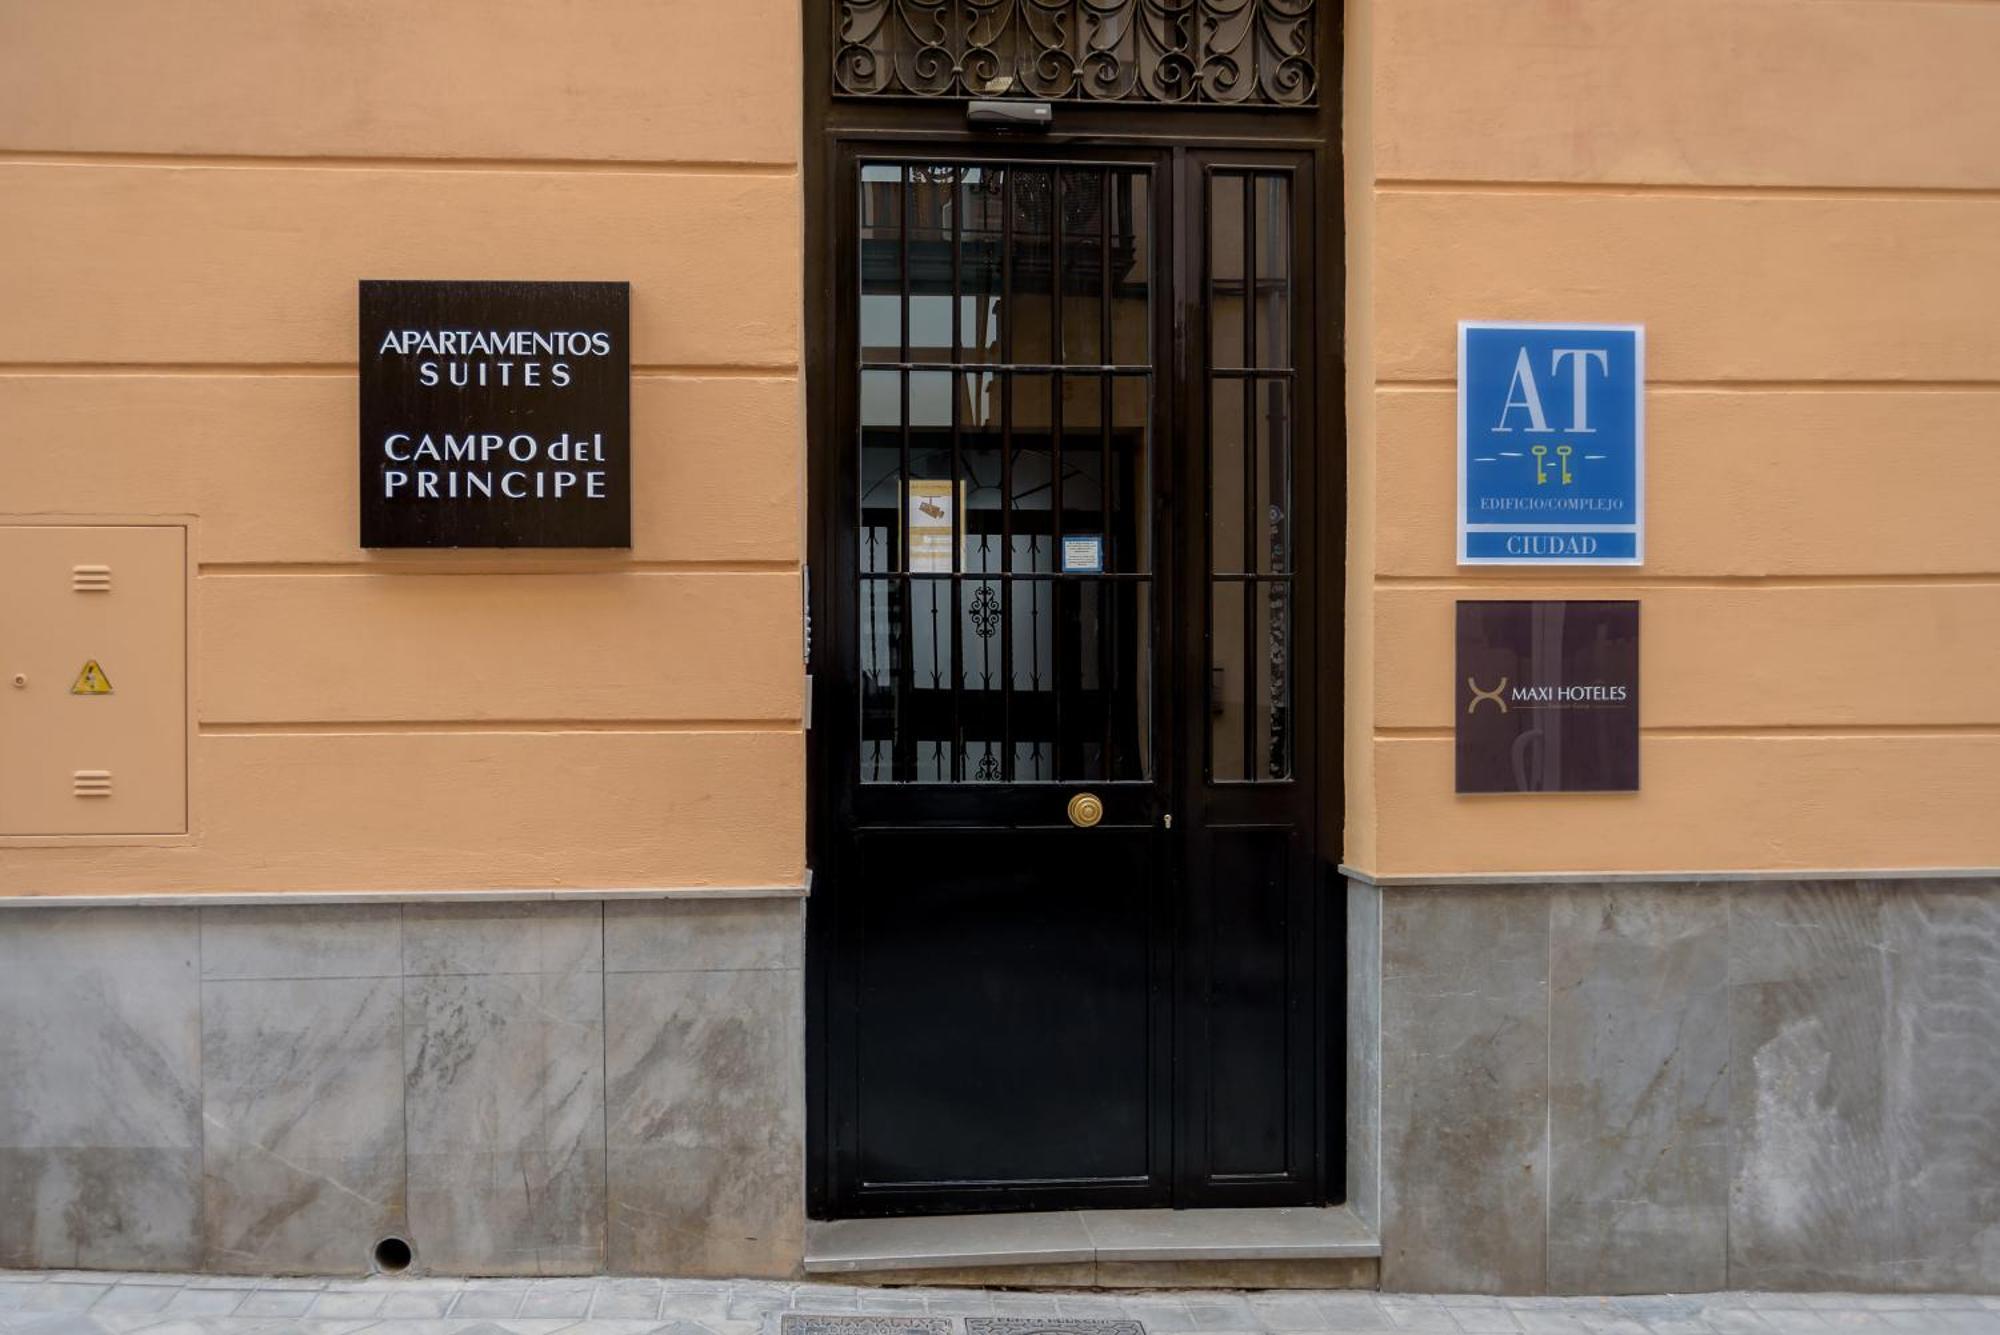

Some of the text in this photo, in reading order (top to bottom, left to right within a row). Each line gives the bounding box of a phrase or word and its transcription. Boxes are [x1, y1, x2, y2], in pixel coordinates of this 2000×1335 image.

[379, 330, 611, 356] APARTAMENTOS
[419, 362, 571, 387] SUITES
[1490, 346, 1609, 433] AT
[384, 433, 538, 462] CAMPO
[384, 471, 606, 499] PRINCIPE
[1506, 535, 1598, 555] CIUDAD
[1511, 686, 1627, 701] MAXI HOTELES
